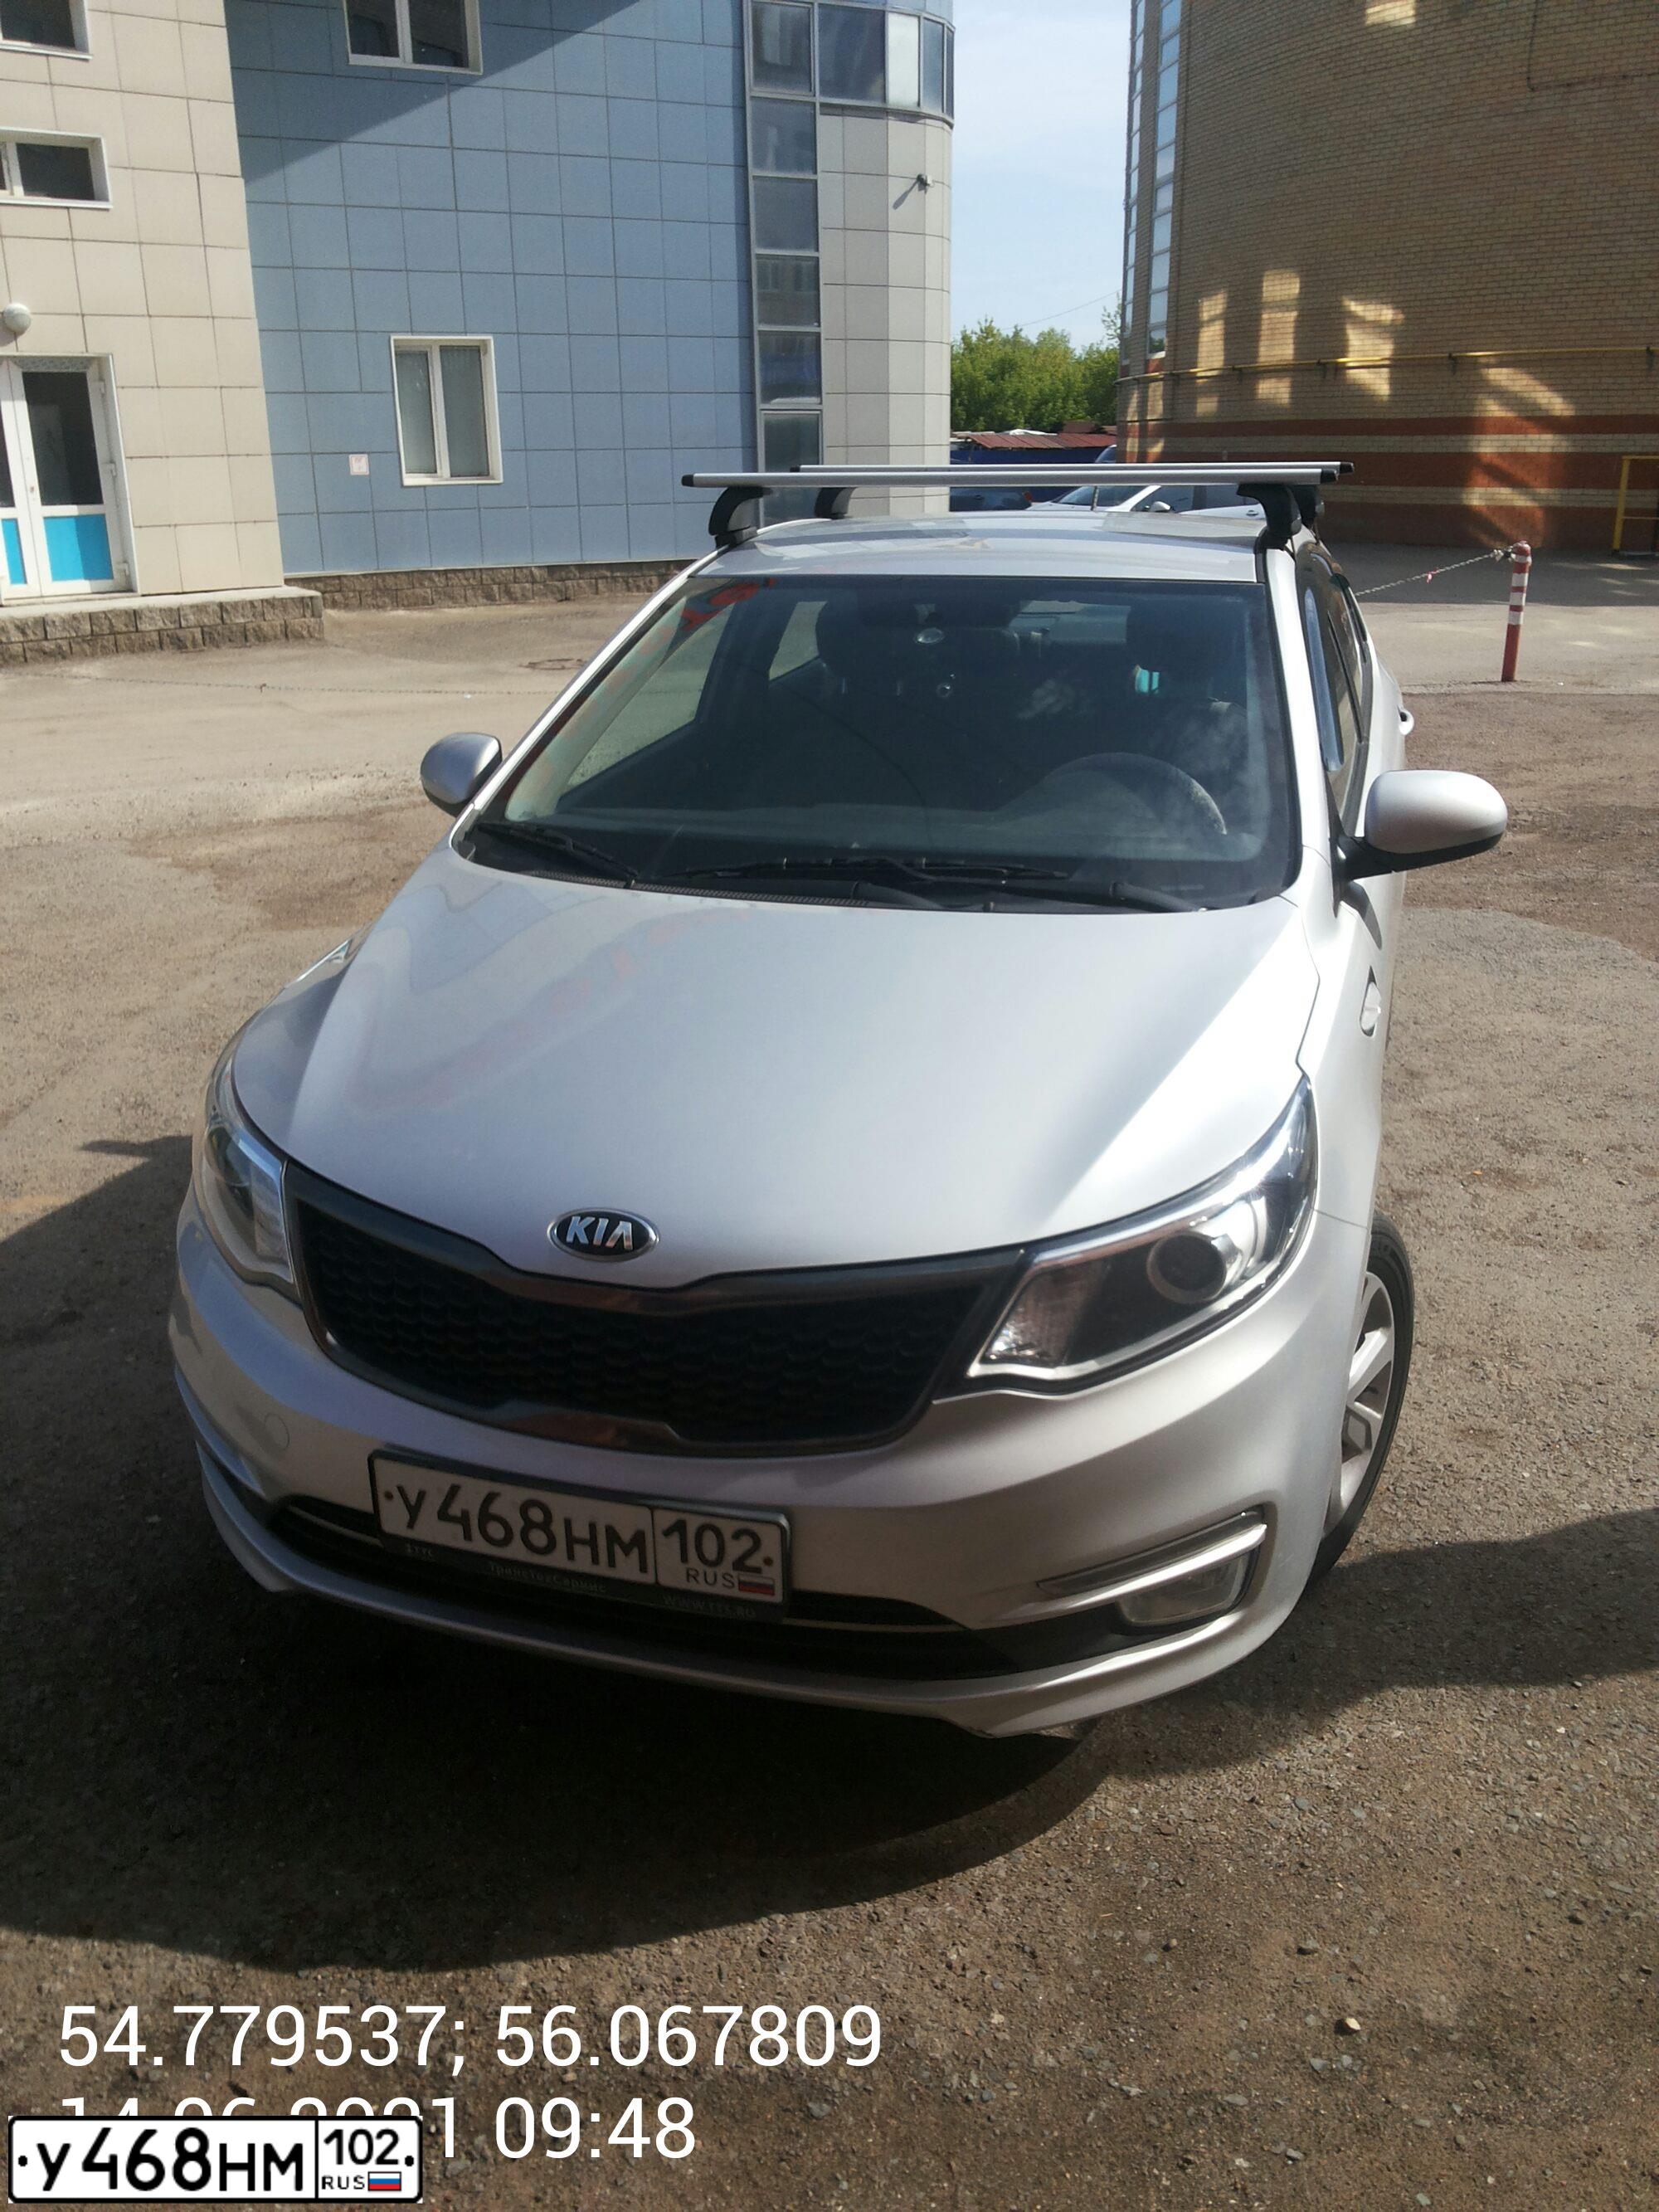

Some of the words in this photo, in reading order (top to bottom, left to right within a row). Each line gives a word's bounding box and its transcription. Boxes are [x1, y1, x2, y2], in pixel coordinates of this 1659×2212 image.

[566, 1216, 633, 1250] KIA
[662, 1518, 763, 1575] 102
[686, 1567, 734, 1590] RUS
